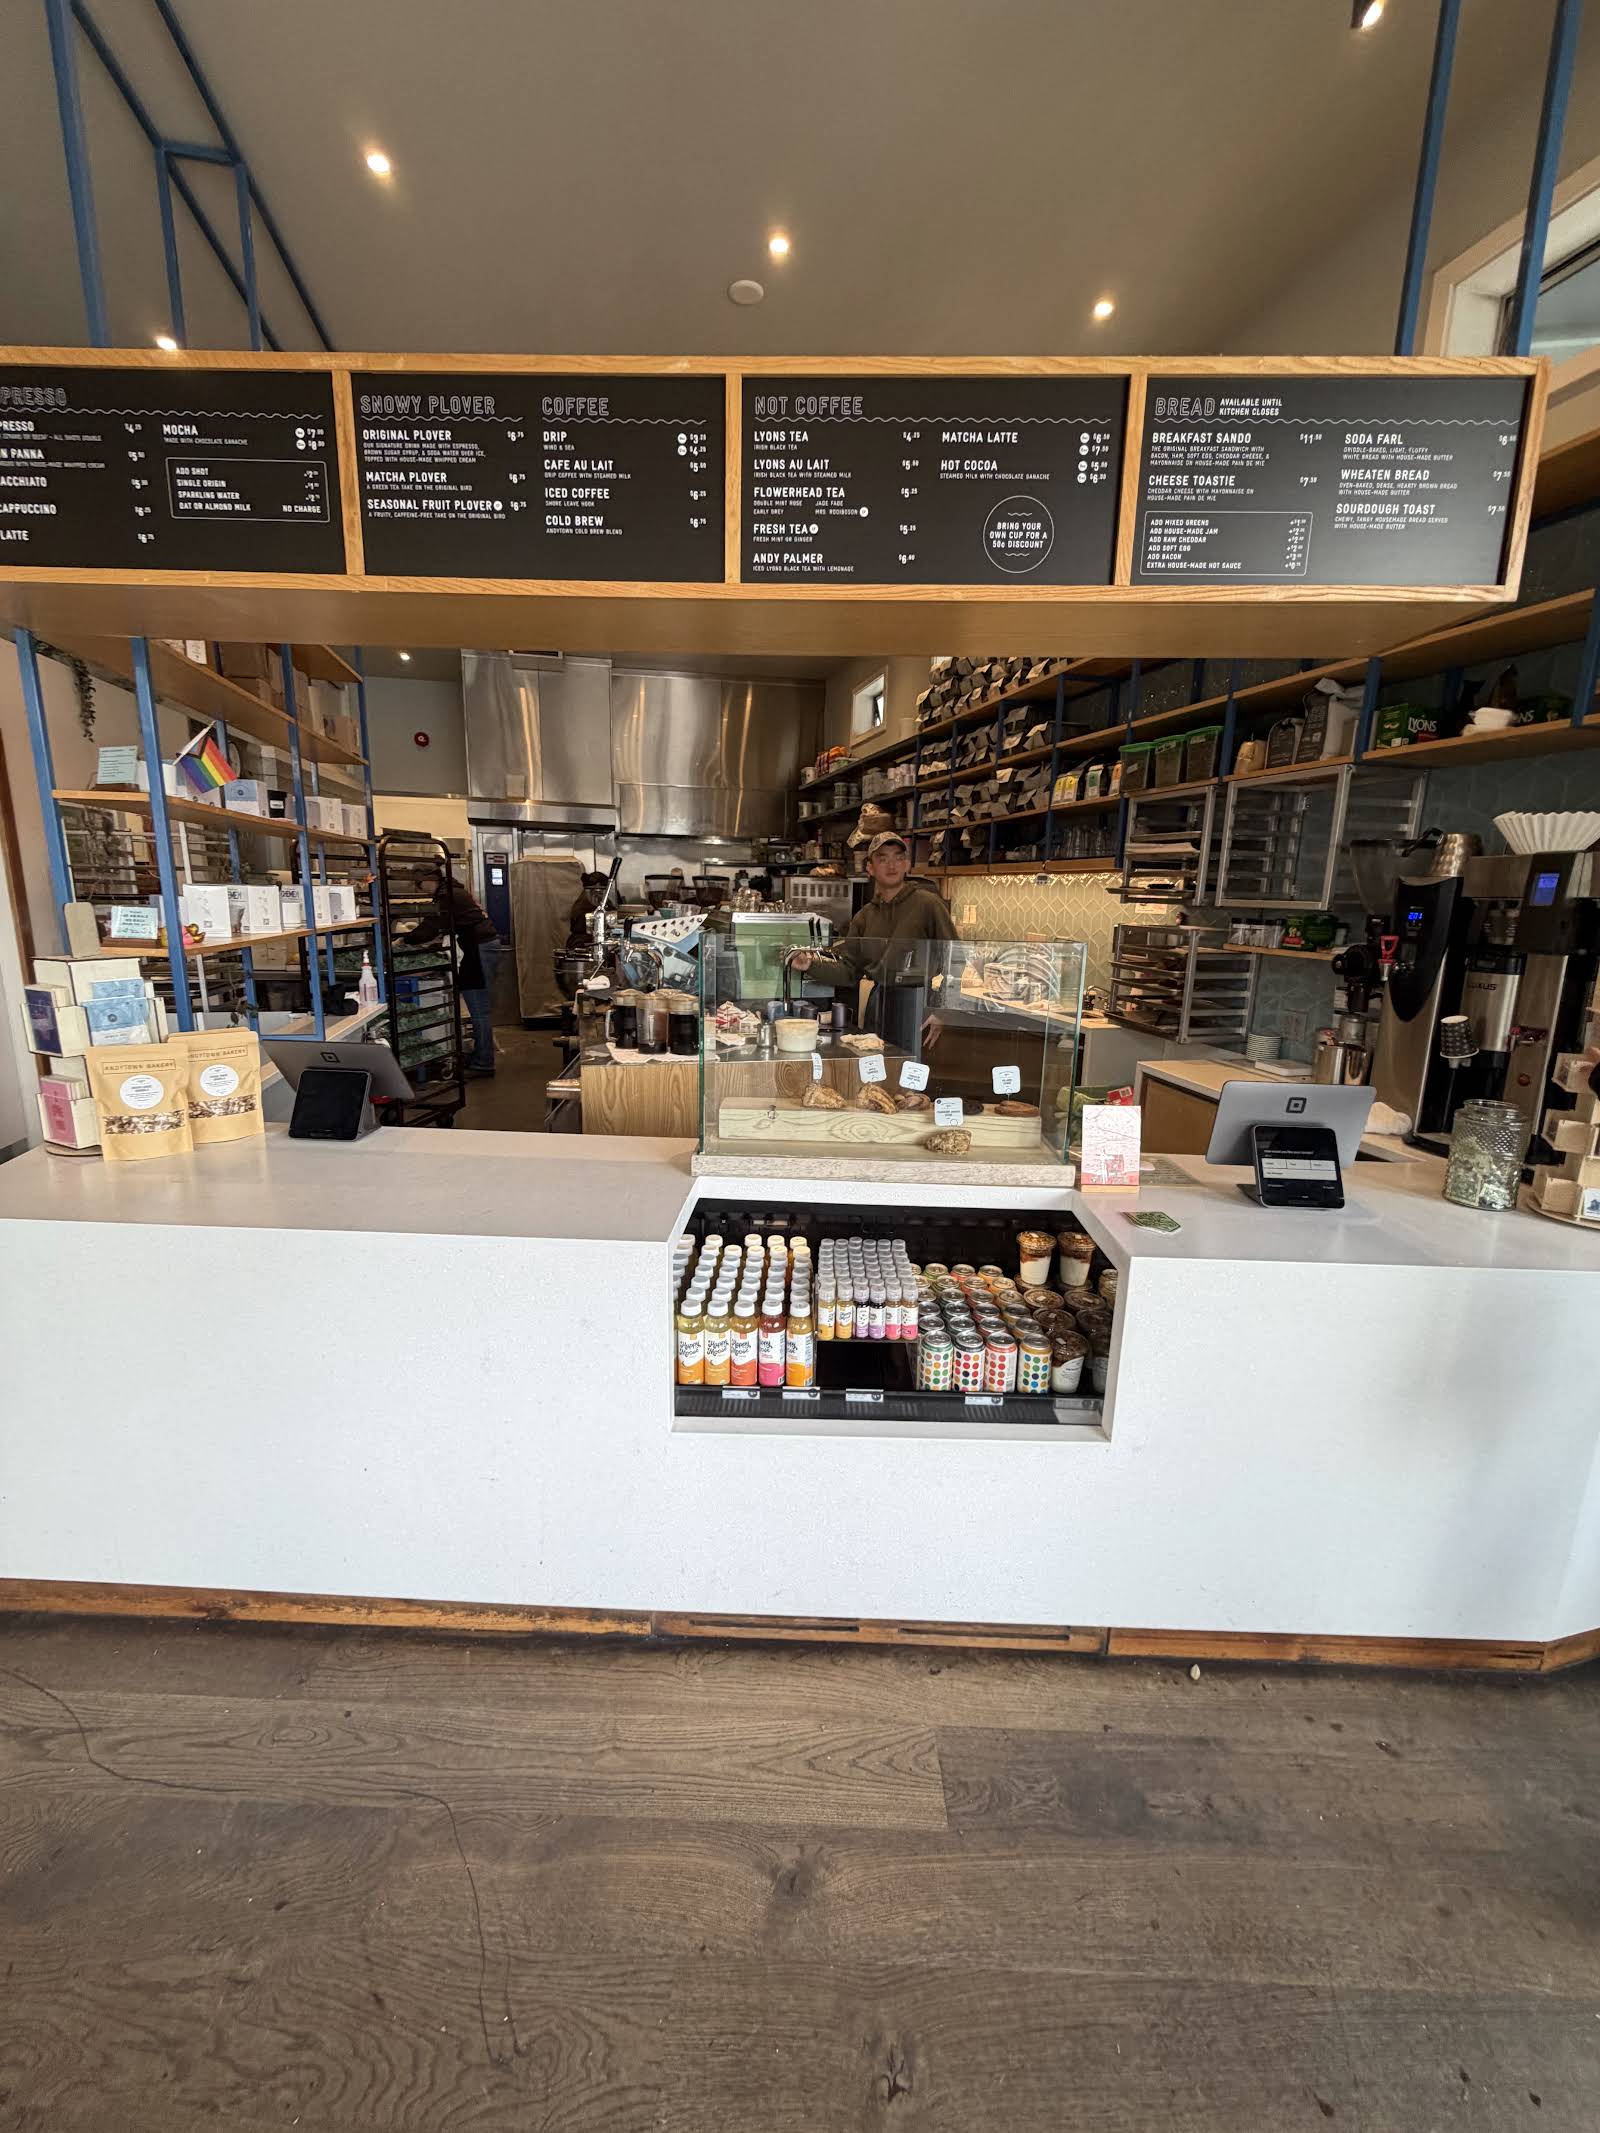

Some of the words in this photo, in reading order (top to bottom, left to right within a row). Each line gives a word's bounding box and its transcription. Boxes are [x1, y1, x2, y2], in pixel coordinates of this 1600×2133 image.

[0, 386, 66, 406] PRESSO
[360, 395, 421, 414] SNOWY
[428, 396, 495, 414] PLOVER
[542, 397, 609, 416] COFFEE
[755, 396, 788, 414] NOT
[795, 396, 863, 415] COFFEE
[1153, 398, 1217, 416] BREAD
[162, 424, 199, 435] MOCHA
[363, 430, 410, 440] ORIGINAL
[413, 430, 451, 440] PLOVER
[507, 431, 524, 441] $6.75
[543, 431, 567, 442] DRIP
[754, 431, 786, 442] LYONS
[790, 431, 808, 441] TEA
[942, 432, 983, 442] MATCHA
[987, 432, 1018, 443] LATTE
[1152, 432, 1213, 443] BREAKFAST
[1215, 433, 1252, 443] SANDO
[1344, 434, 1373, 444] SODA
[1375, 434, 1403, 444] FARL
[544, 460, 570, 470] CAFE
[574, 460, 587, 470] AU
[591, 460, 613, 470] LAIT
[754, 459, 785, 469] LYONS
[789, 459, 803, 470] AU
[807, 459, 829, 470] LAIT
[940, 460, 960, 470] HOT
[964, 460, 997, 470] COCOA
[366, 472, 406, 482] MATCHA
[409, 472, 447, 482] PLOVER
[509, 474, 526, 483] $6.75
[1340, 469, 1392, 480] WHEATEN
[1393, 470, 1431, 480] BREAD
[0, 476, 47, 487] ACCHIATO
[1148, 475, 1190, 485] CHEESE
[1193, 476, 1236, 486] TOASTIE
[545, 488, 568, 498] ICED
[572, 488, 609, 499] COFFEE
[754, 487, 822, 497] FLOWERHEAD
[826, 487, 845, 497] TEA
[367, 499, 419, 509] SEASONAL
[422, 500, 450, 510] FRUIT
[454, 500, 492, 510] PLOVER
[510, 501, 526, 511] $6.75
[1335, 504, 1401, 514] SOURDOUGH
[1402, 504, 1436, 514] TOAST
[546, 515, 571, 526] COLD
[575, 516, 603, 526] BREW
[754, 524, 785, 534] FRESH
[790, 524, 808, 534] TEA
[997, 522, 1020, 532] BRING
[0, 530, 29, 540] LATTE
[989, 531, 1007, 541] OWN
[1009, 531, 1024, 541] CUP
[753, 553, 779, 563] ANDY
[784, 553, 823, 563] PALMER
[1408, 717, 1437, 732] LYONS
[188, 1051, 221, 1059] NDYTOWN
